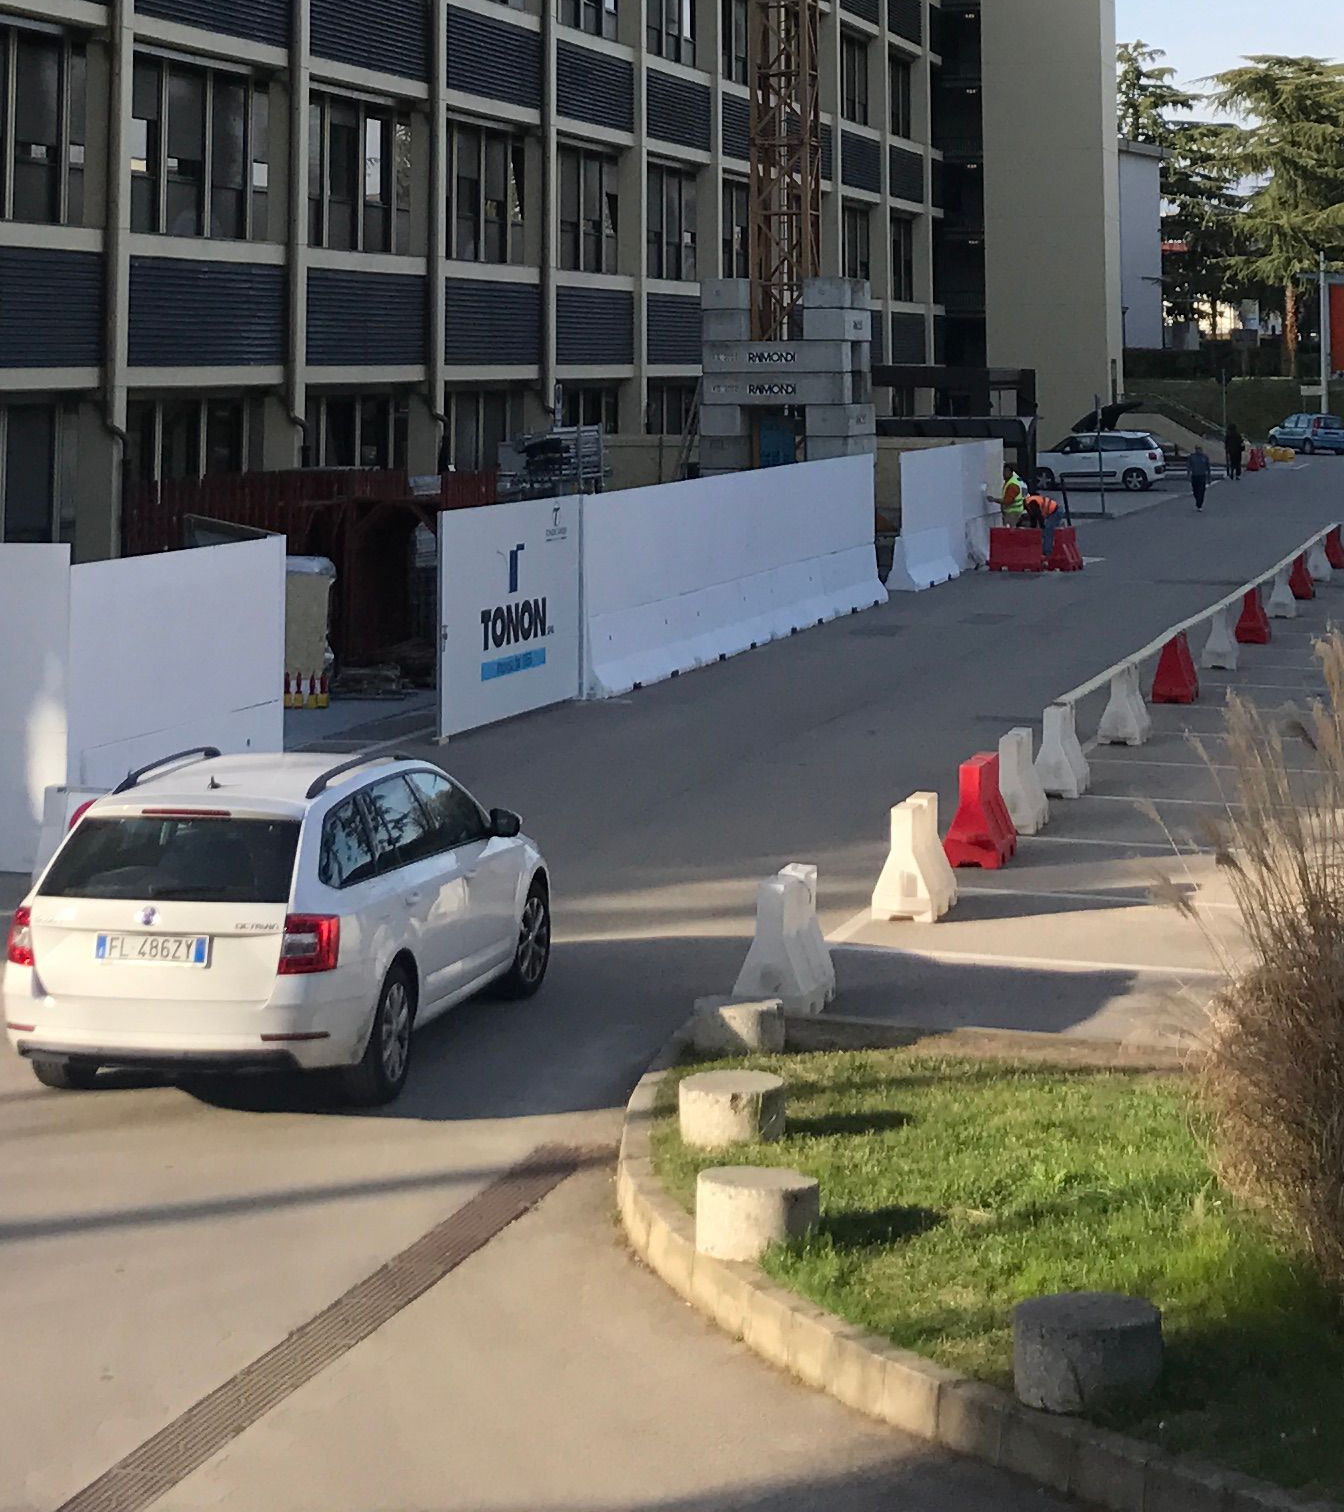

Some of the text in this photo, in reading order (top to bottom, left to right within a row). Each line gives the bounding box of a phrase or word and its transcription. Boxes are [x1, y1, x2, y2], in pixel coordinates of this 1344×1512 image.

[748, 352, 796, 363] RAIMONDI
[748, 384, 797, 395] RAIMONDI
[481, 597, 547, 651] TONON
[108, 937, 194, 959] FL 486ZY
